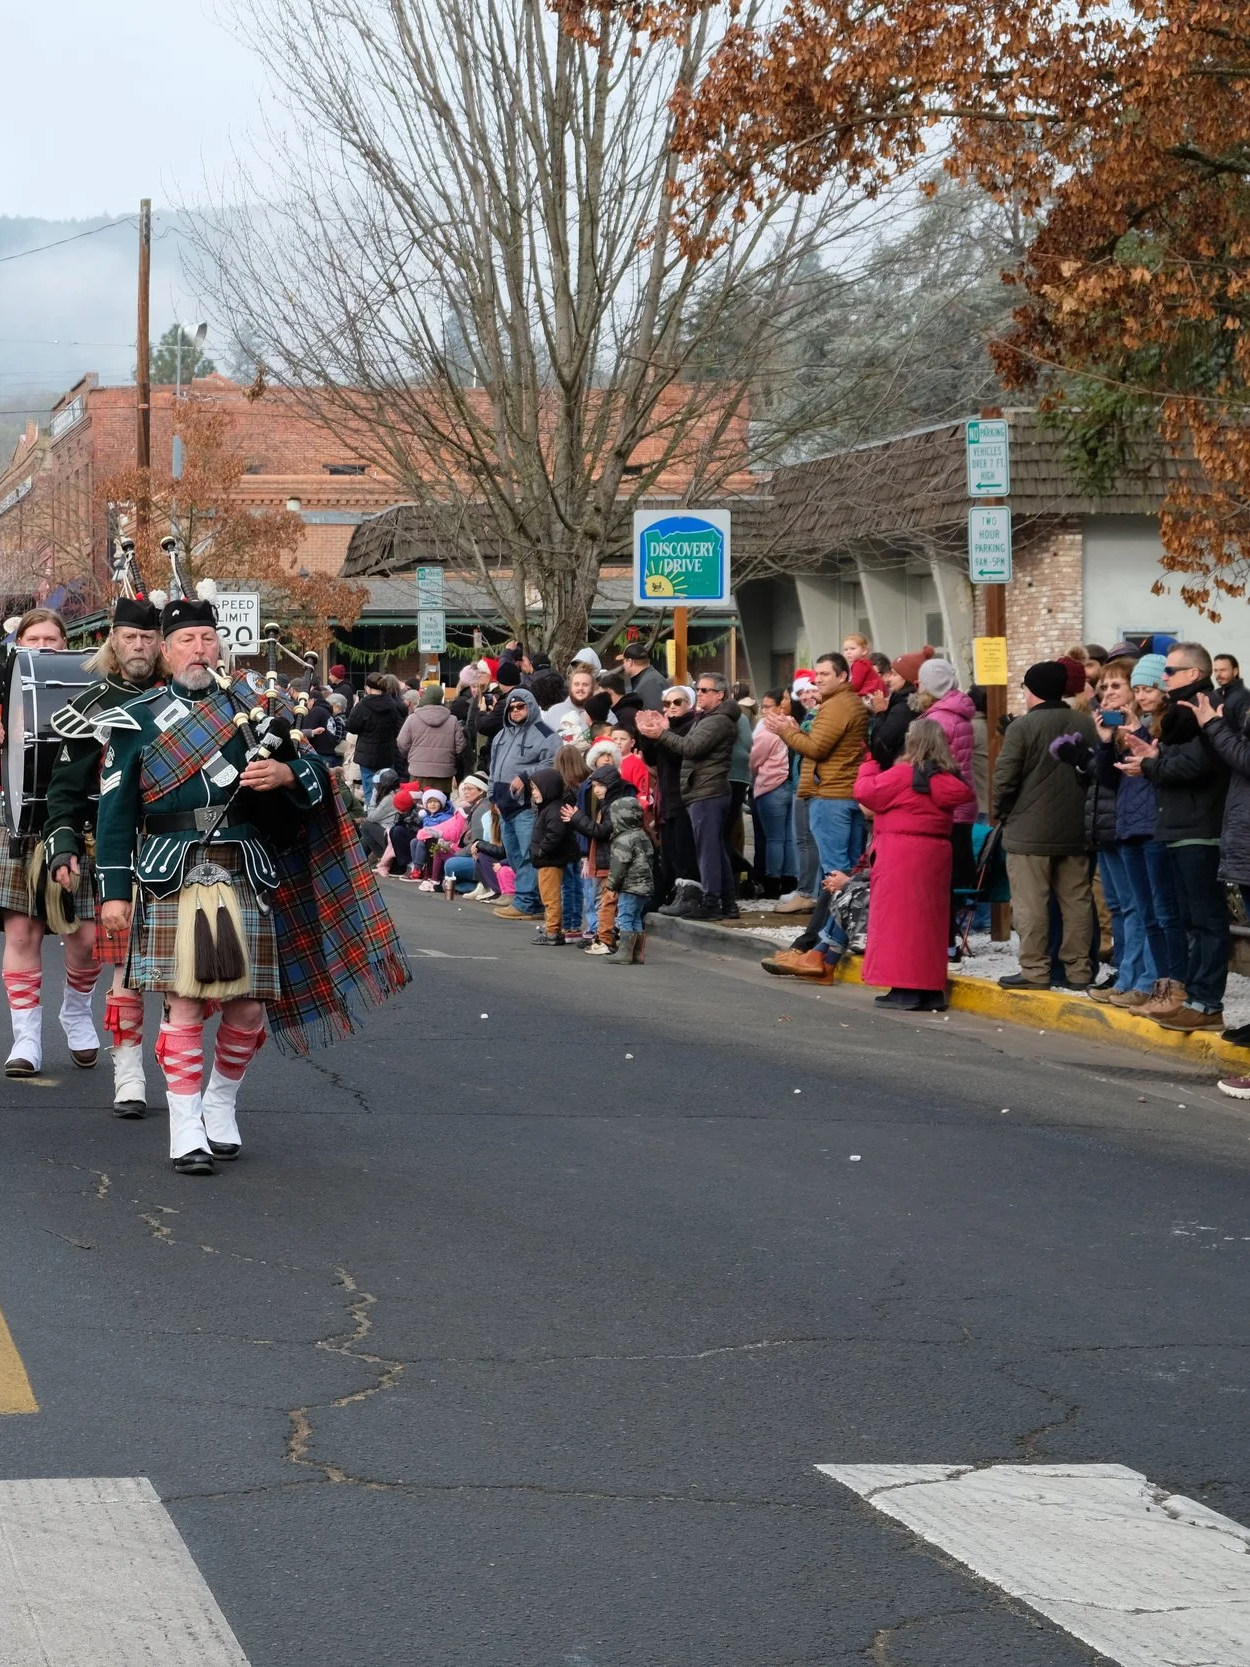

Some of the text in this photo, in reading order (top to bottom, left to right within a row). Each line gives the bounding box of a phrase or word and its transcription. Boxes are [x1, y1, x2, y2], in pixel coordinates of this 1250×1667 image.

[980, 427, 1005, 437] PARKING
[973, 446, 1002, 456] VEHICLES
[972, 459, 987, 468] OVER
[981, 471, 995, 480] HIGH
[982, 516, 997, 526] TWO
[979, 530, 1000, 540] HOUR
[650, 542, 715, 557] DISCOVERY
[975, 544, 1005, 553] PARKING
[664, 558, 703, 573] DRIVE
